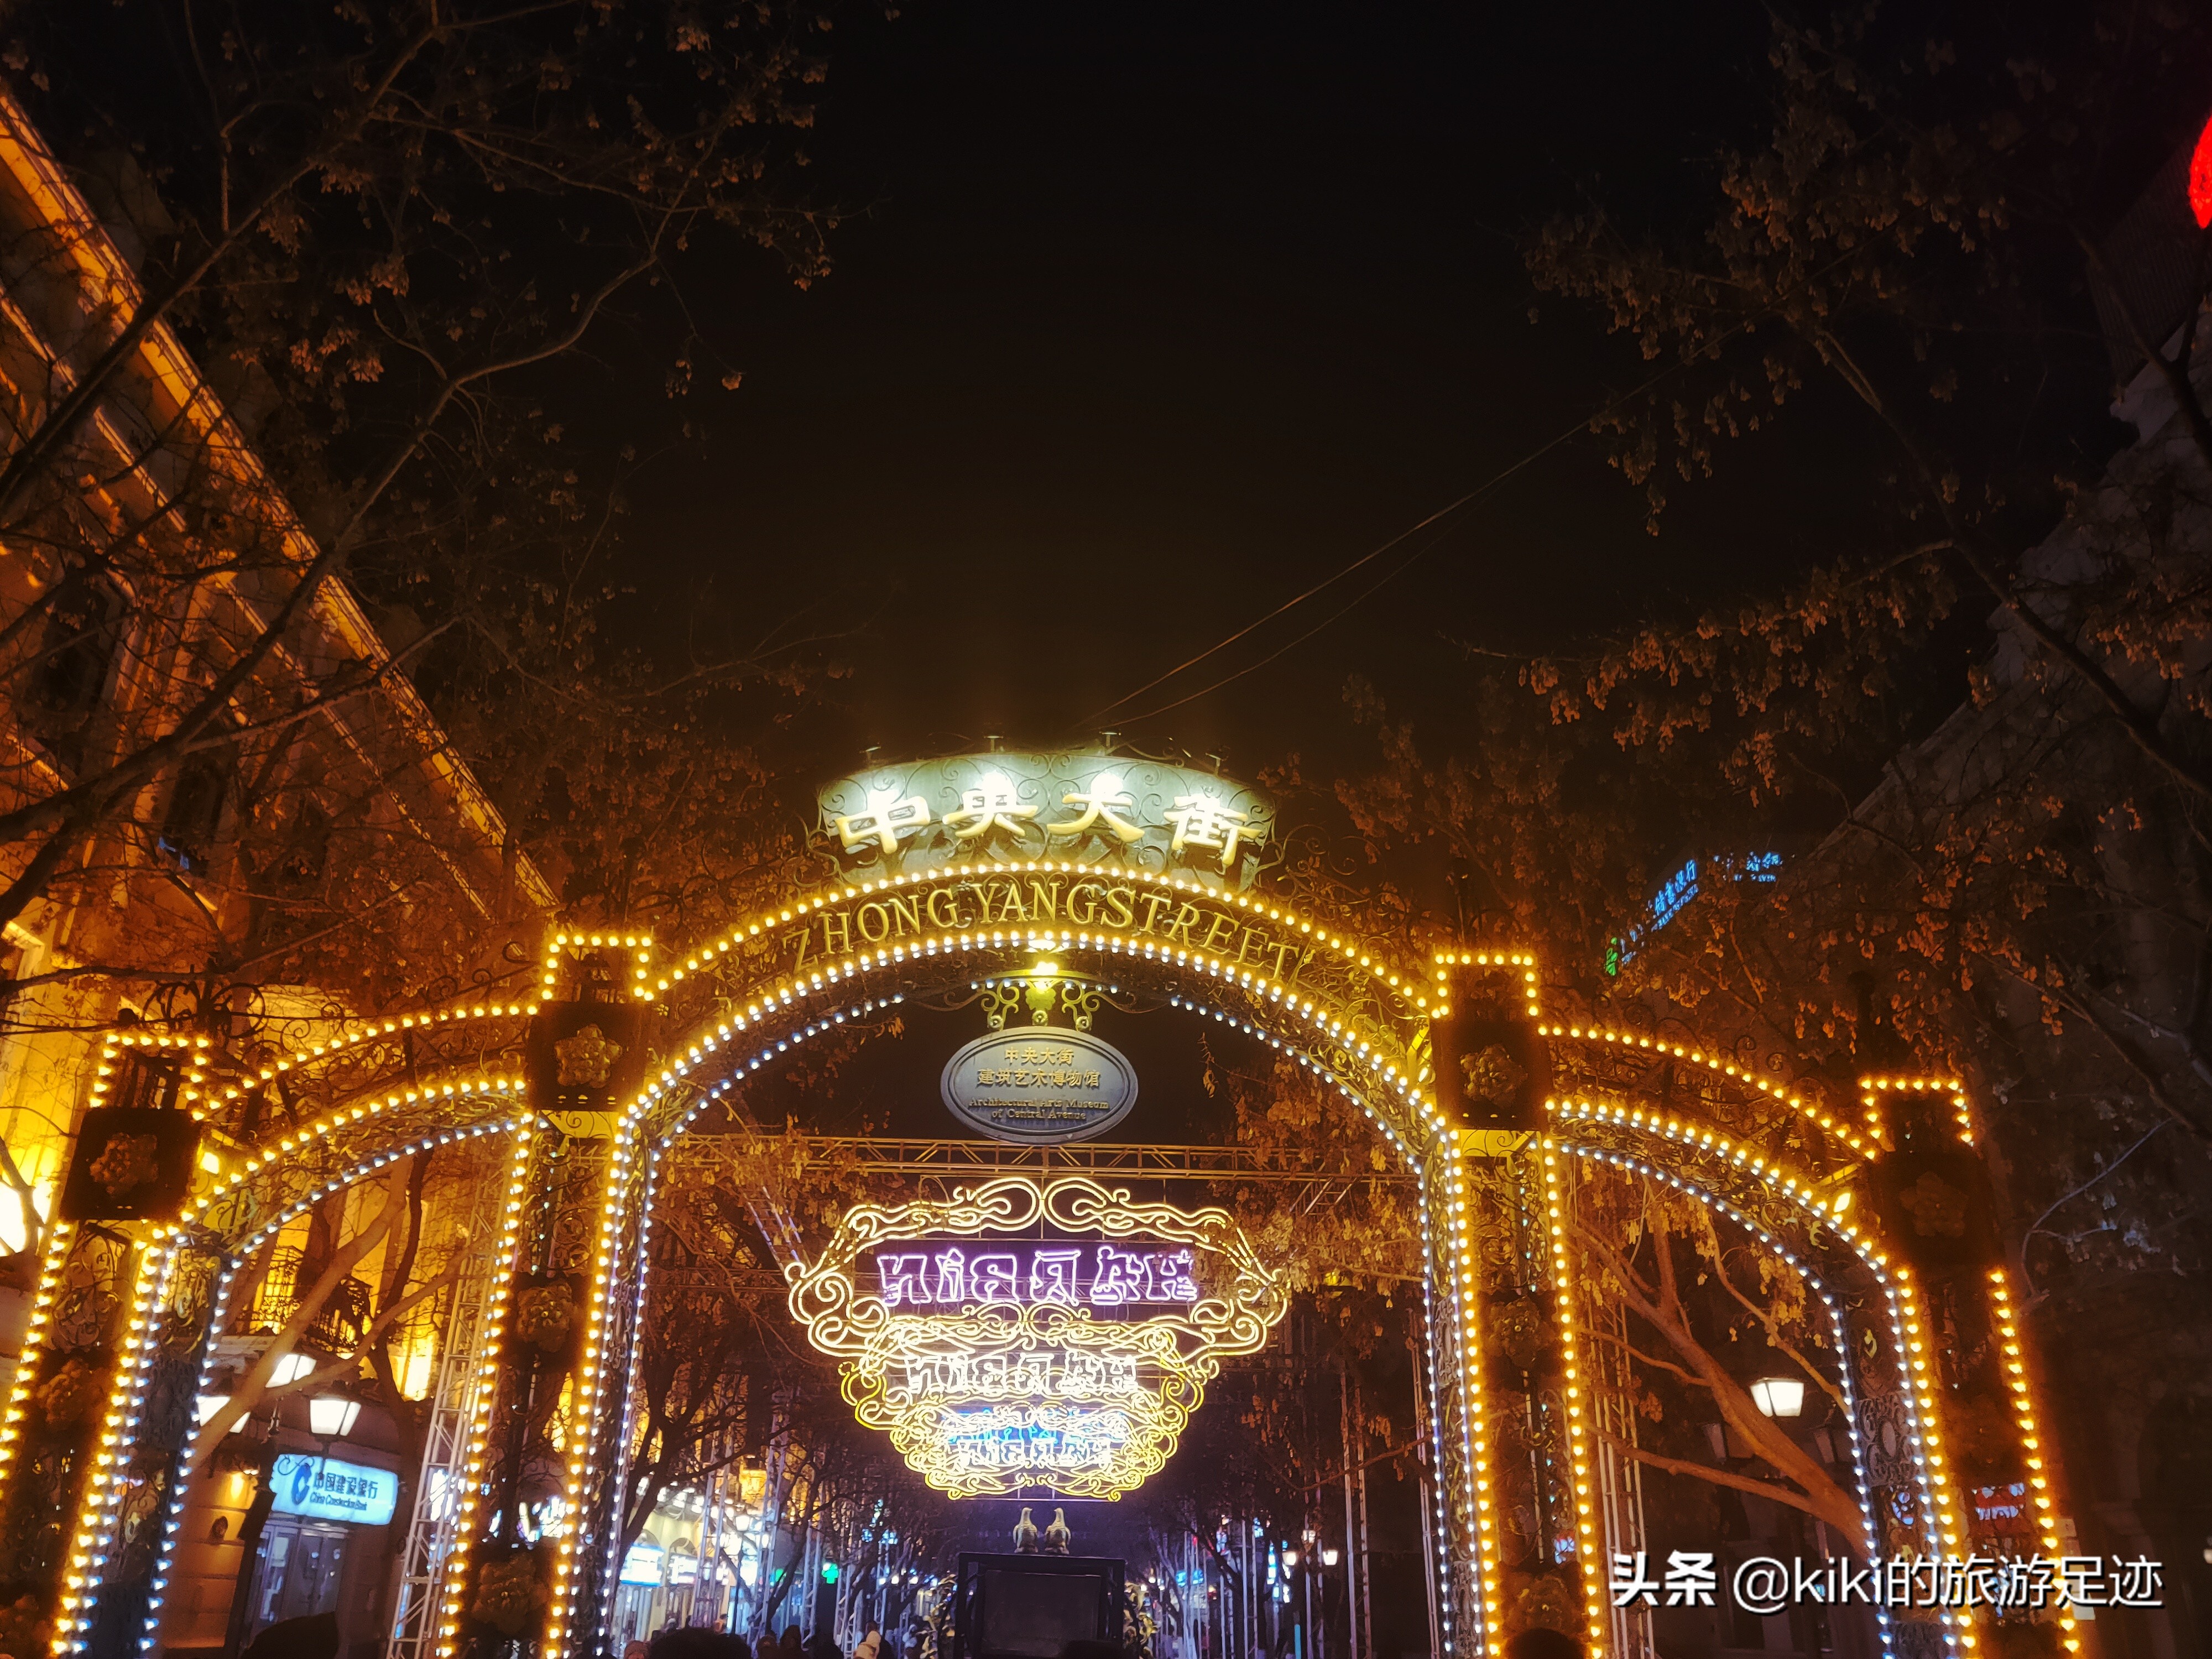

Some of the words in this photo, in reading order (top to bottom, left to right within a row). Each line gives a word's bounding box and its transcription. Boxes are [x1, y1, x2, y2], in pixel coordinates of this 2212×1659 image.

[835, 773, 1261, 867] 中央大街
[1005, 1046, 1074, 1065] 中央大街
[977, 1068, 1101, 1088] 建筑艺术博物馆
[1066, 1098, 1109, 1109] Museum
[992, 1109, 1002, 1119] of
[1006, 1108, 1046, 1119] Central
[1048, 1109, 1087, 1120] Avenue
[313, 1472, 378, 1499] 中国建设银行
